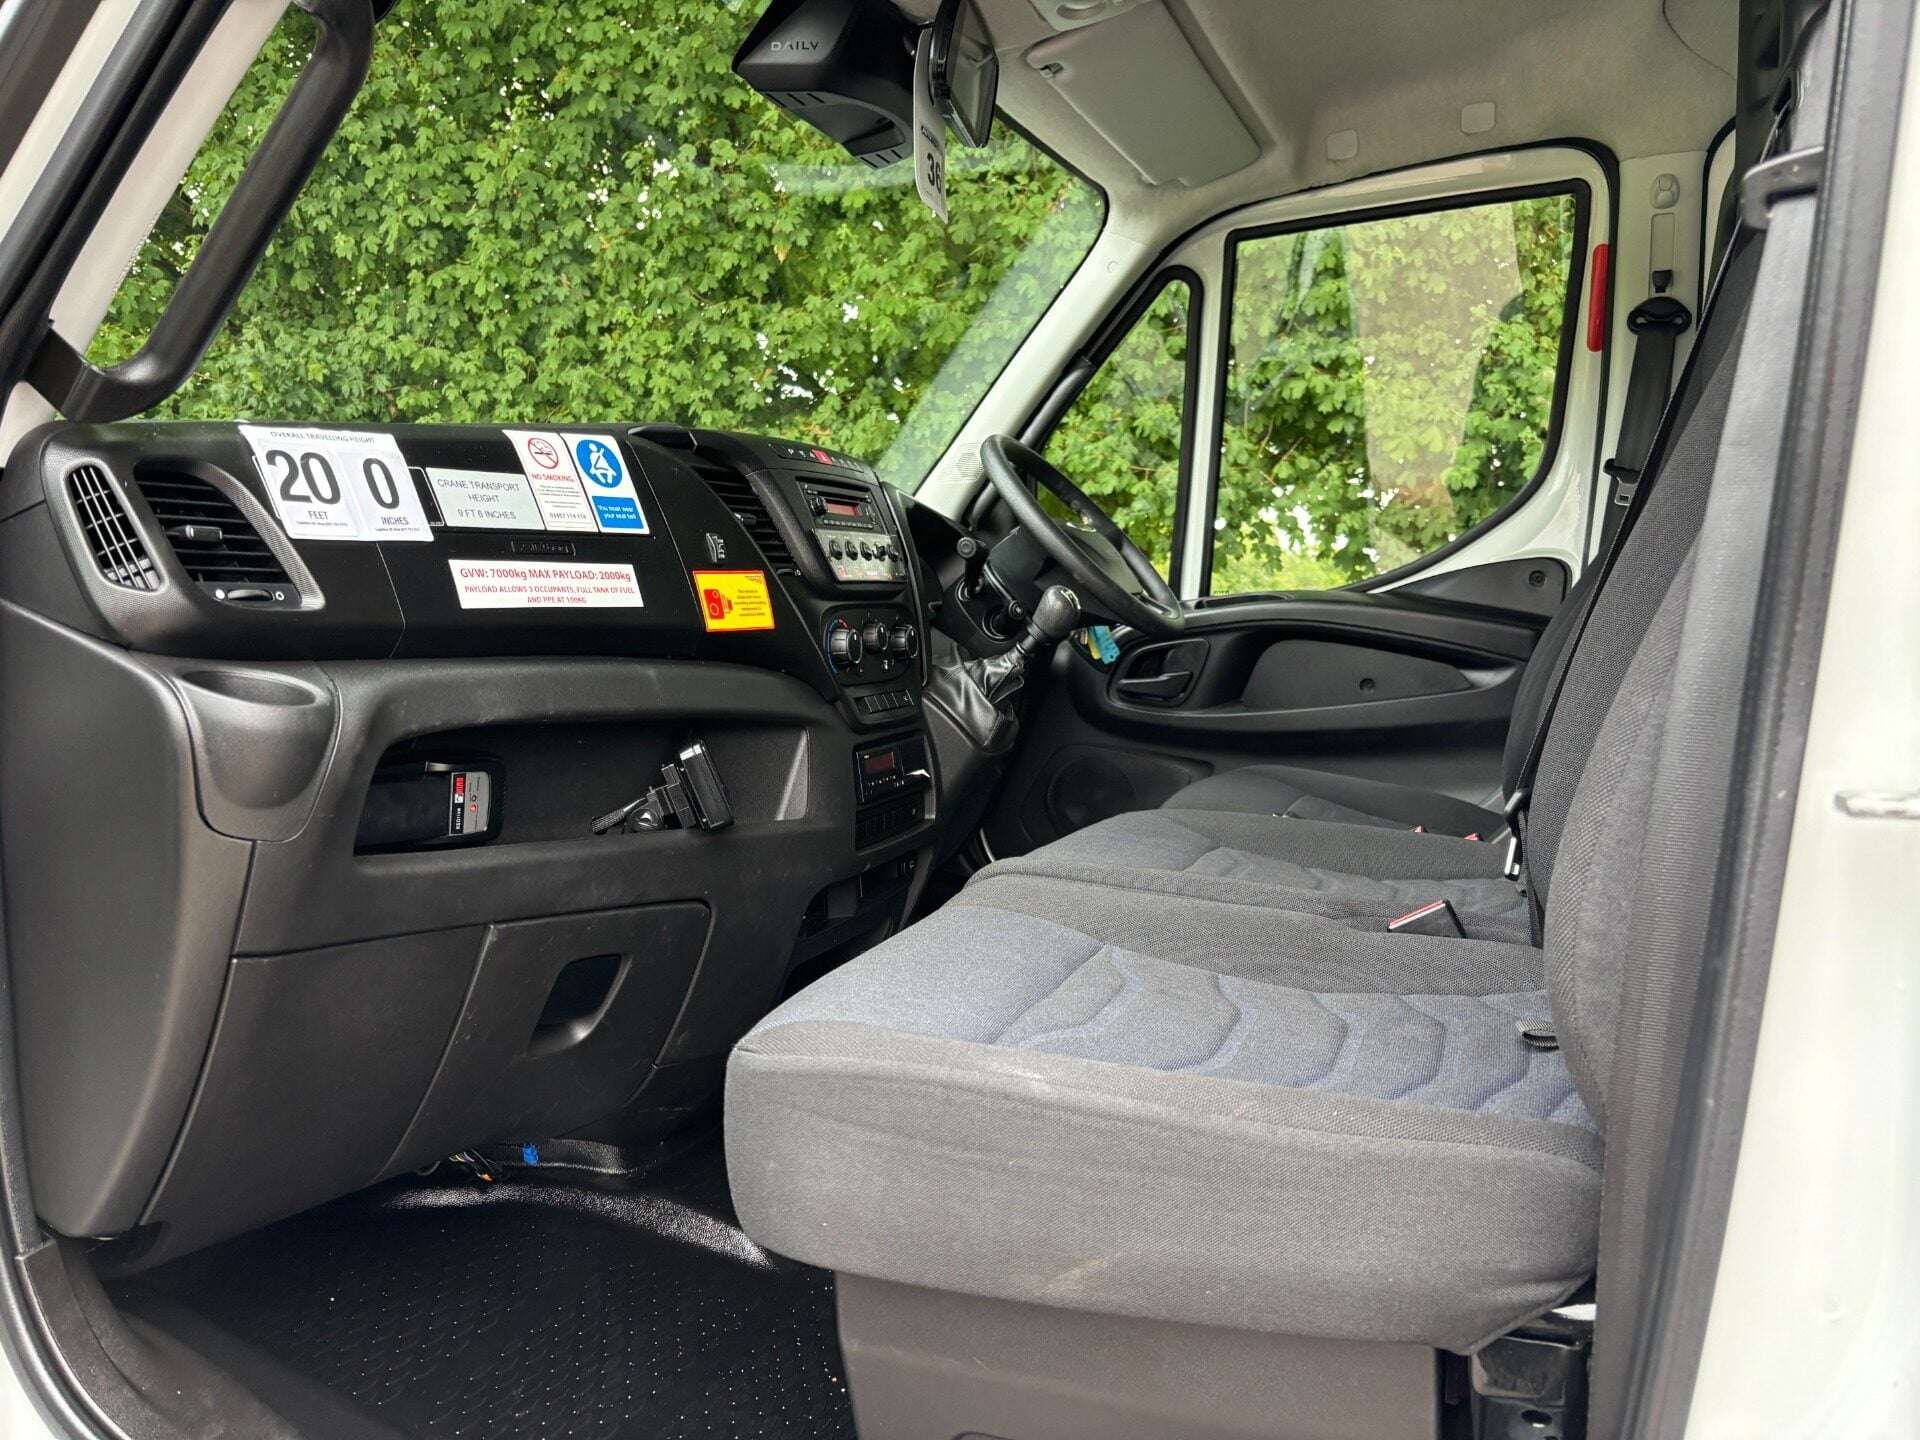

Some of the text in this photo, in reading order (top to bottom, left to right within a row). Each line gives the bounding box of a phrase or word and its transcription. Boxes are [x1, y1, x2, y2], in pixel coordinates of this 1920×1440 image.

[770, 40, 820, 51] DAILY
[270, 431, 304, 439] OVERALL
[306, 433, 349, 442] TRAVELLING
[266, 450, 341, 505] 20
[542, 474, 575, 483] SMOKING
[363, 458, 400, 510] 0
[437, 479, 520, 492] CRANE TRANSPORT
[468, 494, 500, 503] HEIGHT
[308, 510, 328, 520] FEET
[464, 509, 475, 518] FT
[485, 510, 517, 520] INCHES
[381, 516, 409, 526] INCHES
[460, 568, 631, 582] GVW: 7000kg MAX PAYLOAD: 2000kg
